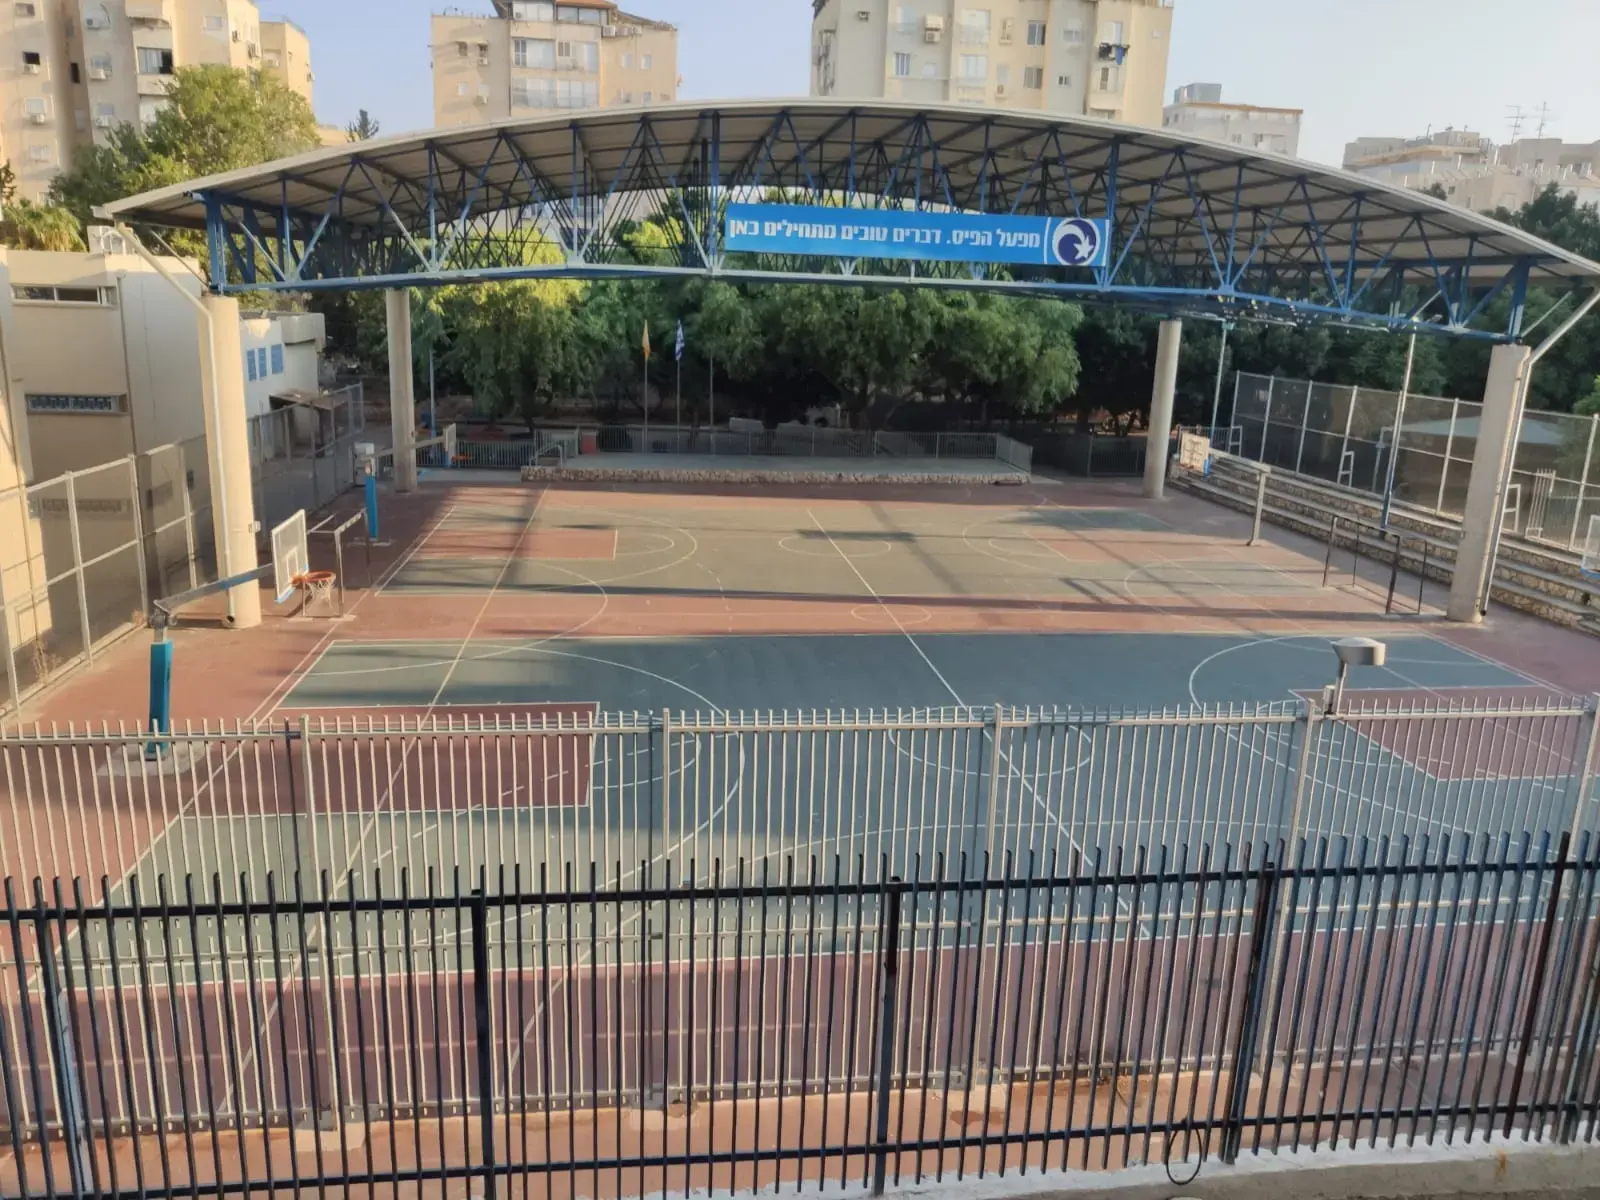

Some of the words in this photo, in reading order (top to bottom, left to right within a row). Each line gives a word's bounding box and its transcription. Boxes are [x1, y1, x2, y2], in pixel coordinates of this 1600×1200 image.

[730, 219, 759, 238] כאן
[764, 219, 837, 239] מתחילים
[841, 225, 888, 242] טובים
[893, 227, 942, 244] דברים
[996, 229, 1040, 248] מפעל
